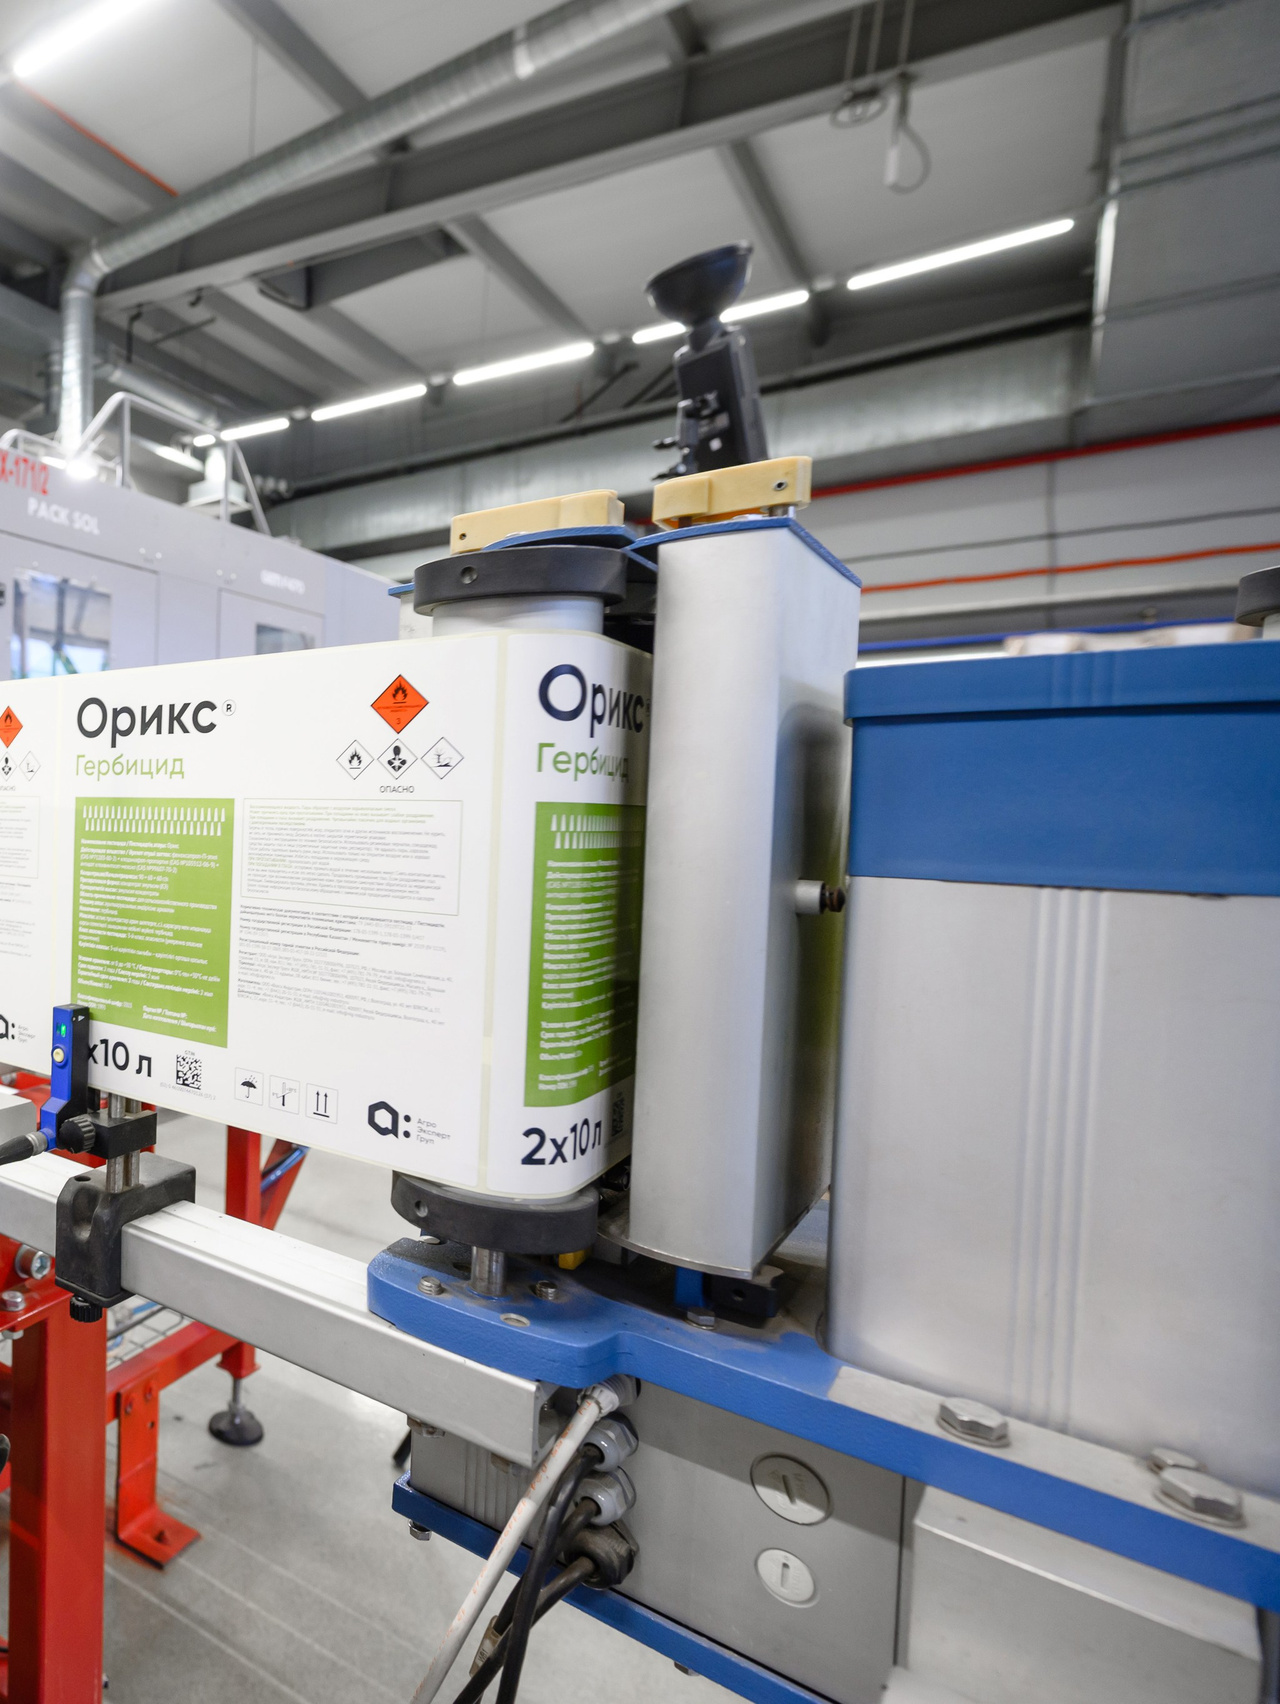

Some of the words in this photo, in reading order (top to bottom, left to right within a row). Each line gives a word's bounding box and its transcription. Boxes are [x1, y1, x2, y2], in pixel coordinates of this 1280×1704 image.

[28, 497, 70, 527] PACK
[72, 510, 101, 535] SOL
[76, 754, 185, 782] Гербицид
[380, 785, 414, 793] ОПАСНО
[136, 1054, 152, 1078] л
[417, 1118, 436, 1128] Агро
